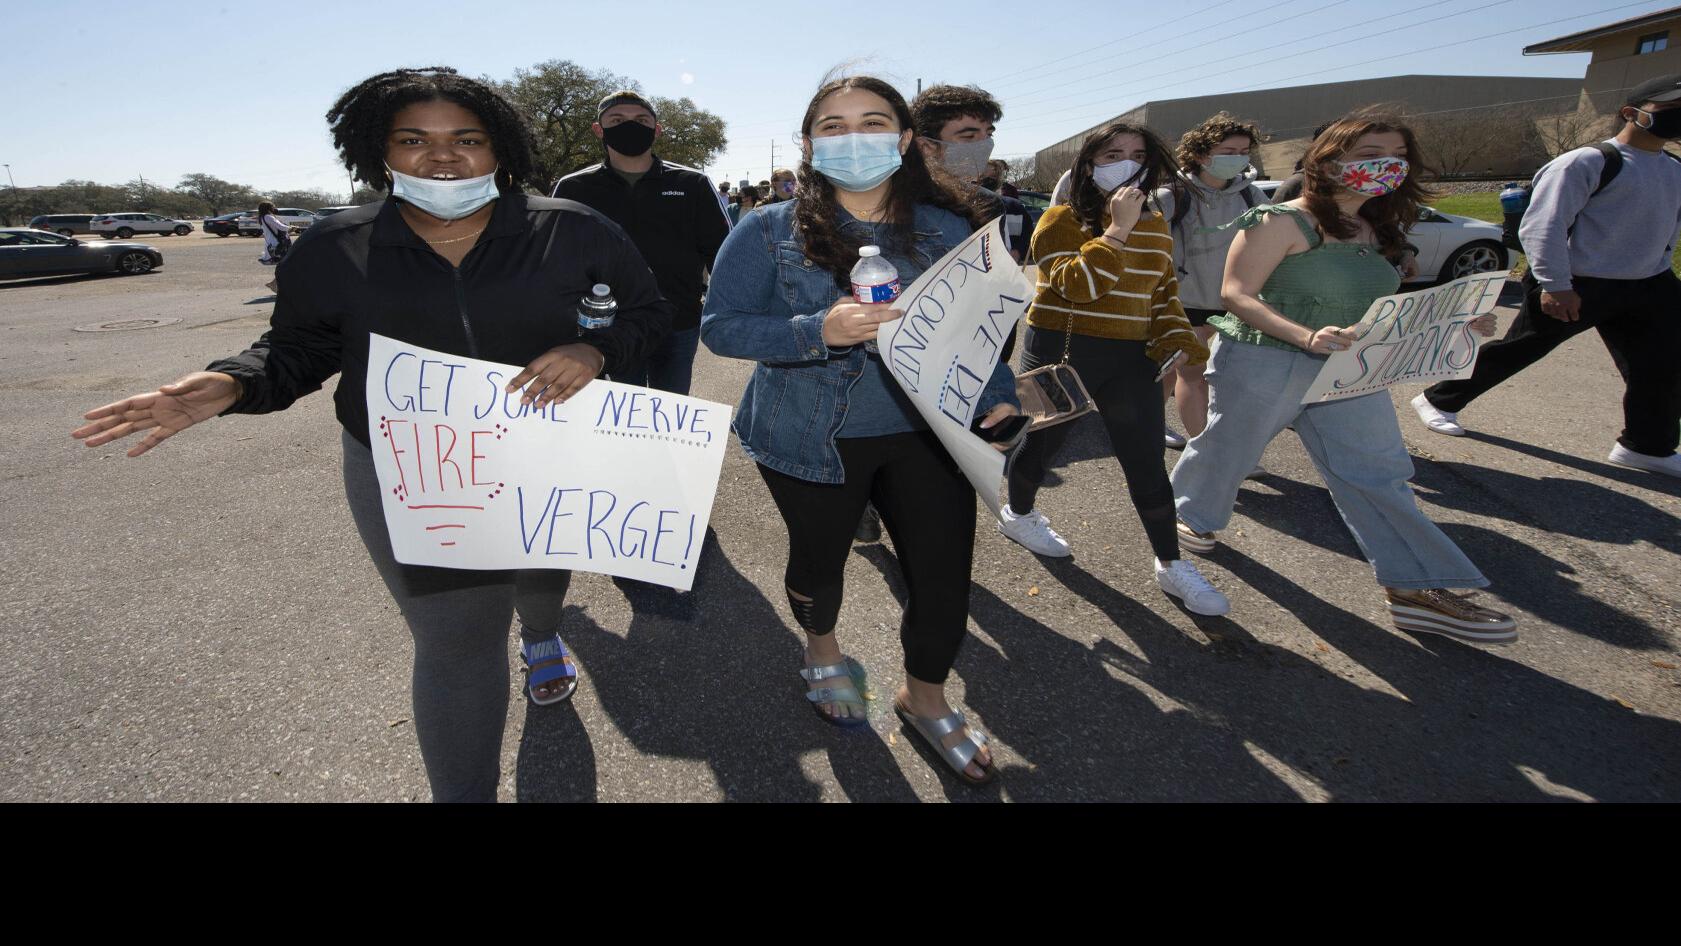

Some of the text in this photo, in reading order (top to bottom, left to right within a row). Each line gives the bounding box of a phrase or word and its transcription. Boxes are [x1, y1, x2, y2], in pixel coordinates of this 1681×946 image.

[973, 294, 1024, 365] WE
[1333, 319, 1478, 389] STUDENTS
[385, 352, 466, 416] GET
[596, 390, 711, 442] NERVE,
[386, 419, 495, 496] FIRE
[517, 486, 695, 570] VERGE!
[530, 640, 560, 660] NIKE
